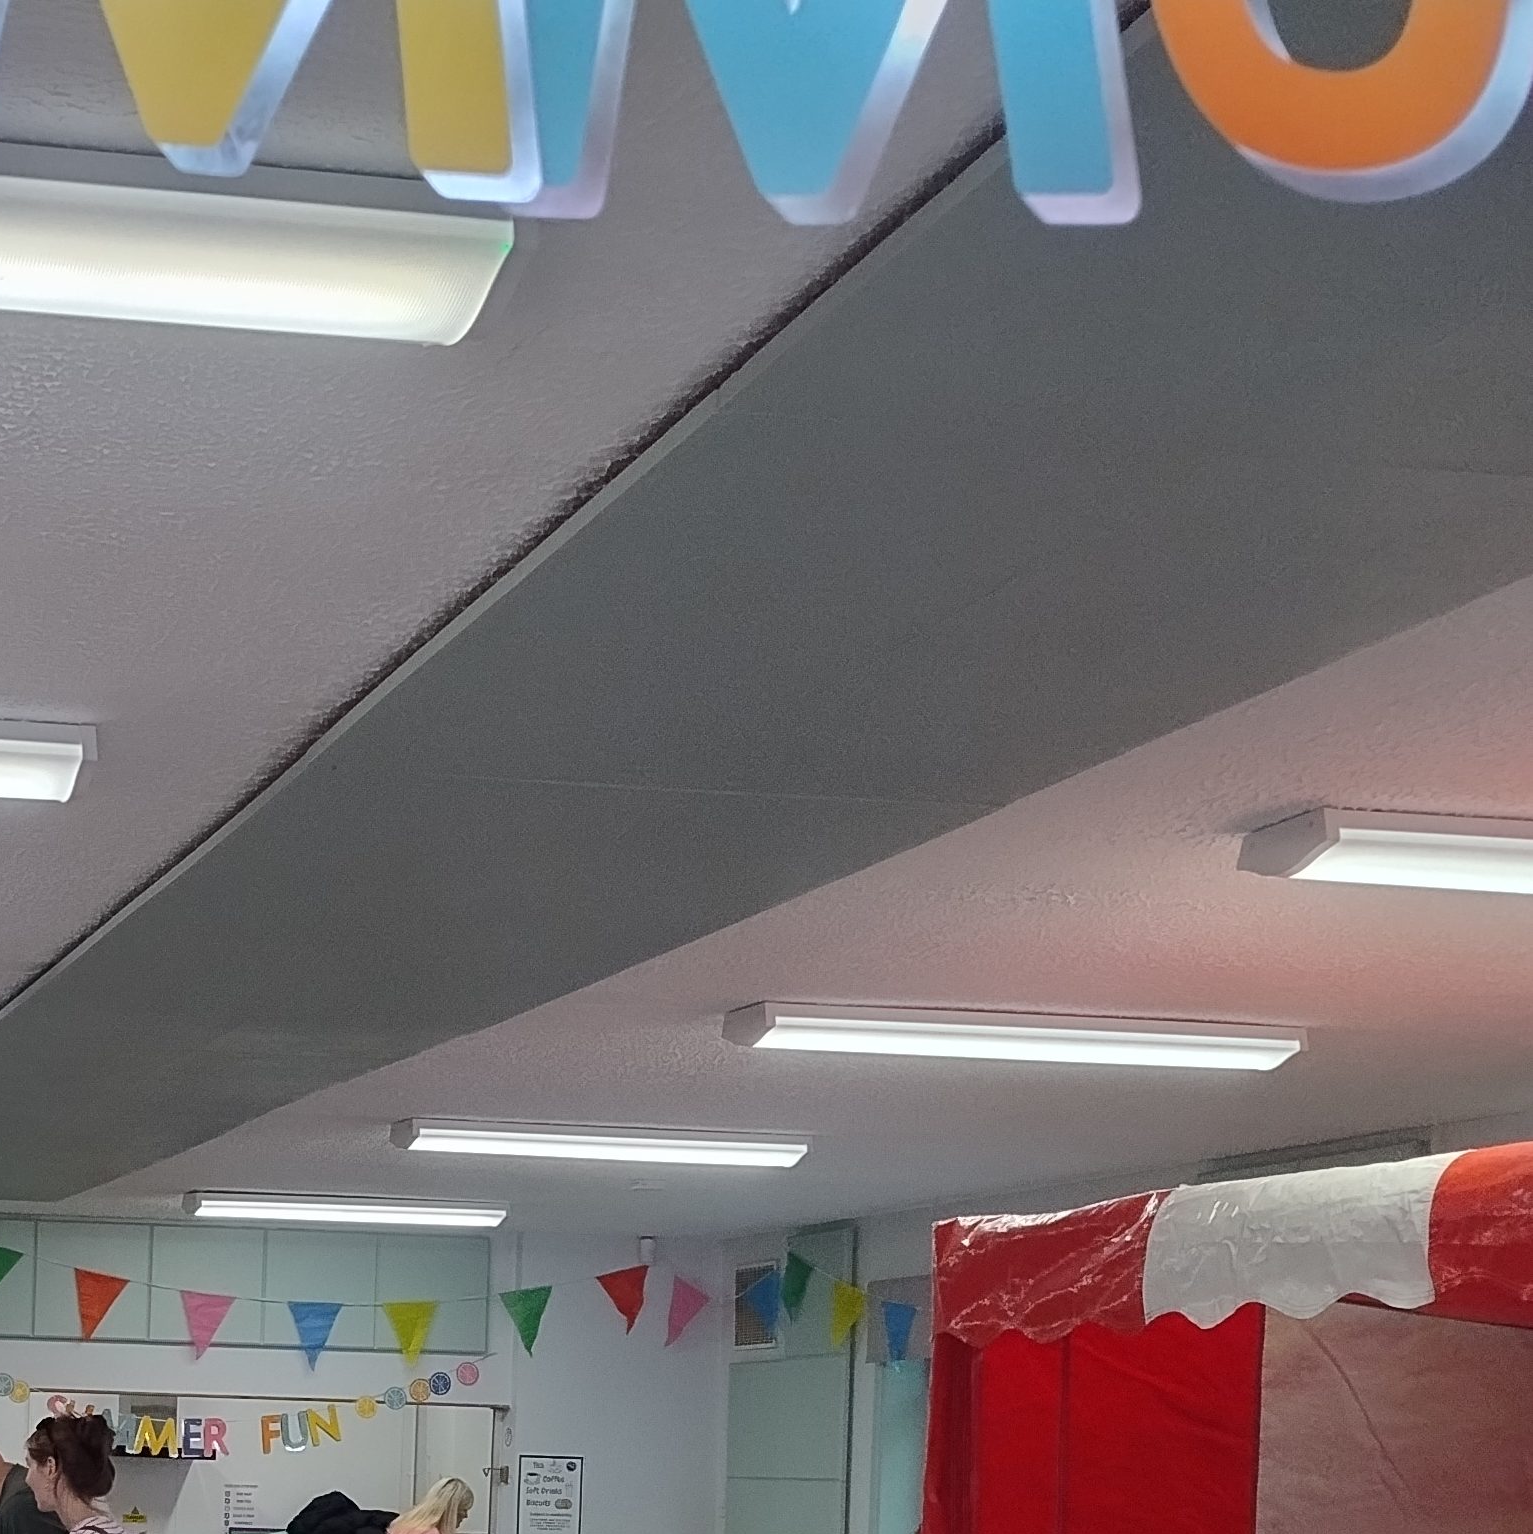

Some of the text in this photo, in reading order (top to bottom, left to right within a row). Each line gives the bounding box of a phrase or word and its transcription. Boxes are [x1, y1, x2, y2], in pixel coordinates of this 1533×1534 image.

[47, 1395, 341, 1458] SMMER FUN
[542, 1475, 565, 1483] Coffee
